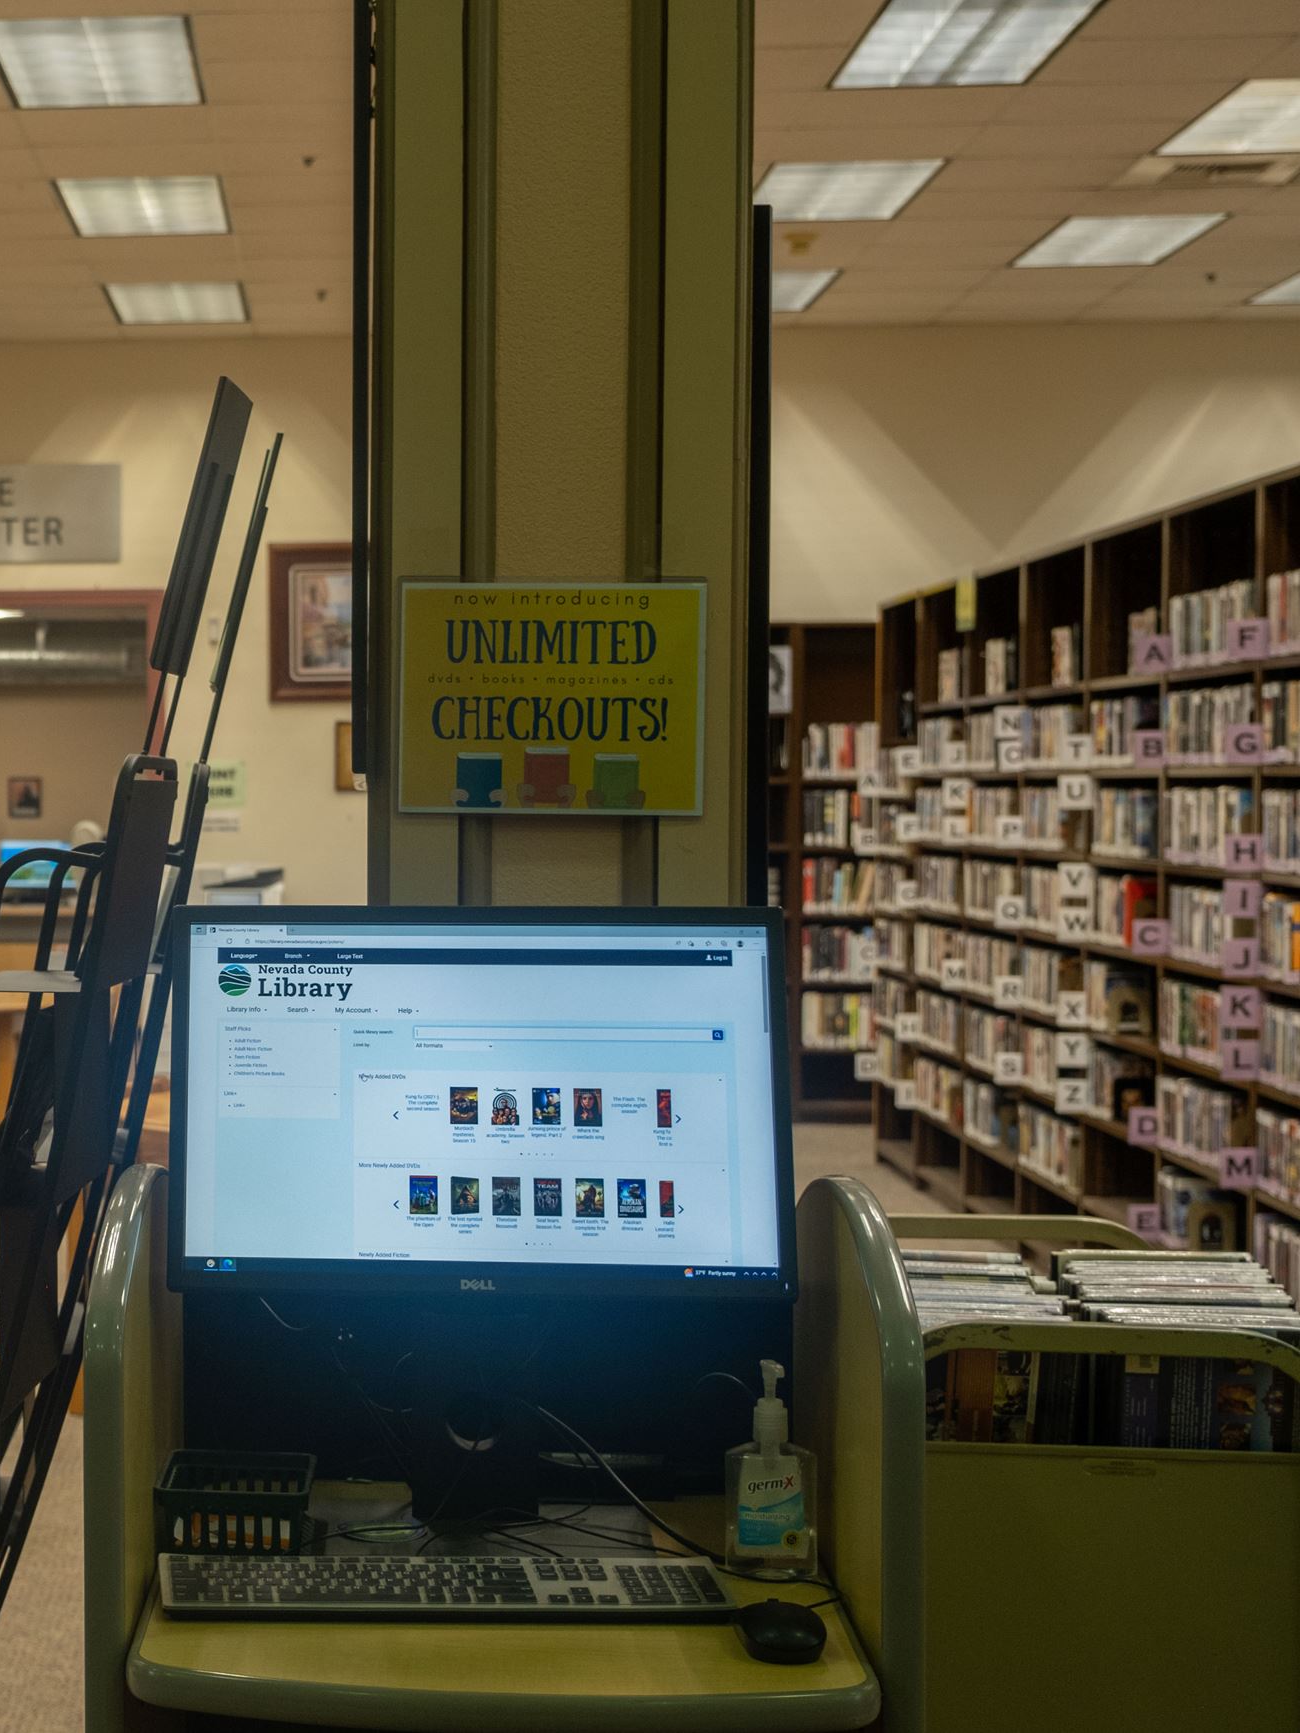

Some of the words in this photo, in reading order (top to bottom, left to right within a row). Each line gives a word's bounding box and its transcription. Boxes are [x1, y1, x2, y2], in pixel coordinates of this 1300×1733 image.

[454, 594, 498, 606] now
[511, 591, 650, 610] introducing
[446, 619, 657, 665] UNLIMITED
[1238, 626, 1260, 649] F
[1144, 644, 1166, 664] A
[428, 674, 461, 684] dvds
[482, 674, 525, 684] books
[546, 674, 627, 688] magazines
[648, 675, 674, 685] cds
[432, 696, 669, 742] CHECKOUTS!
[1070, 742, 1087, 758] T
[1142, 737, 1162, 757] B
[1234, 732, 1256, 755] G
[1066, 781, 1086, 801] U
[1234, 836, 1256, 862] H
[1066, 869, 1085, 888] V
[1064, 916, 1087, 933] W
[1138, 925, 1161, 947] C
[230, 953, 254, 961] Language
[337, 953, 351, 961] Large
[1238, 947, 1250, 970] J
[258, 965, 304, 974] Nevada
[308, 964, 353, 976] County
[258, 977, 353, 1001] Library
[226, 1006, 247, 1014] Library
[334, 1007, 343, 1015] My
[397, 1007, 412, 1015] Help
[1066, 1001, 1082, 1016] X
[1230, 995, 1251, 1017] K
[1065, 1039, 1081, 1055] Y
[1234, 1046, 1251, 1069] L
[1066, 1085, 1081, 1102] Z
[1138, 1116, 1157, 1135] D
[1227, 1156, 1251, 1179] M
[460, 1279, 496, 1290] DELL
